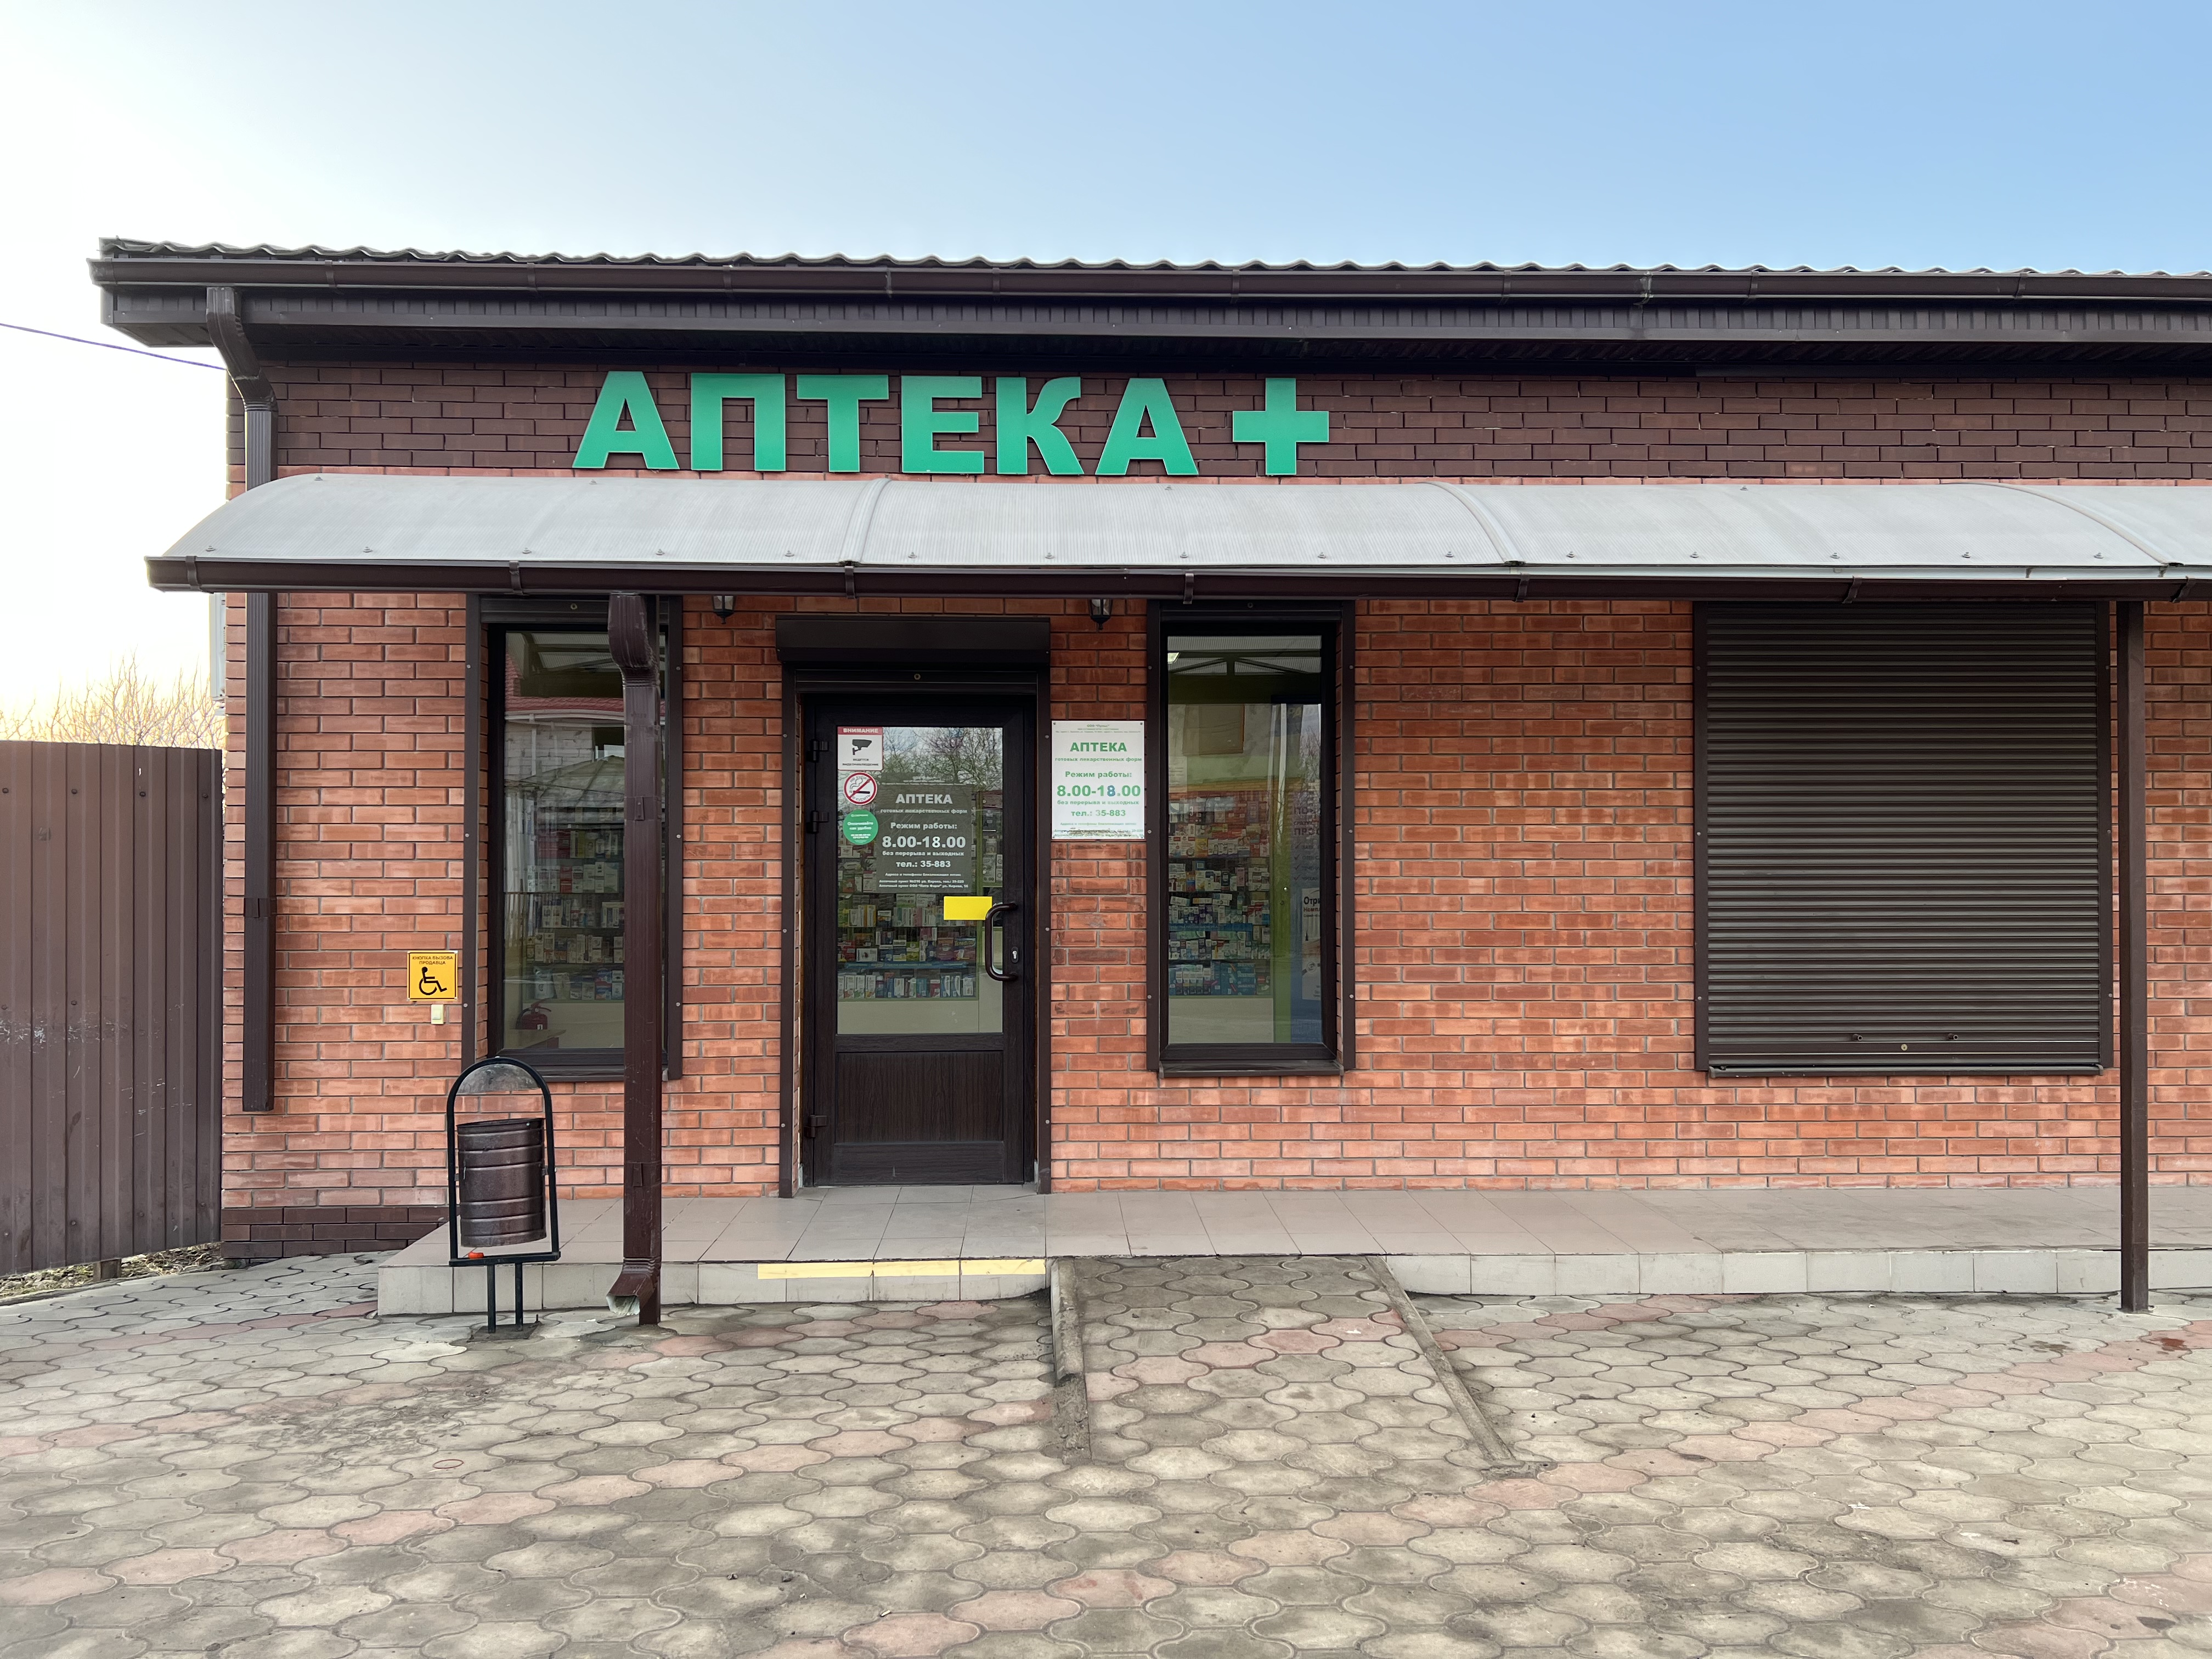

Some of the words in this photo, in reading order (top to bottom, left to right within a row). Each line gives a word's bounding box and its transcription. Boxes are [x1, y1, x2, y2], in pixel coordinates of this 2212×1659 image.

[572, 370, 1200, 476] АПТЕКА
[1070, 742, 1127, 752] АПТЕКА
[1057, 785, 1141, 797] 8.00-18.00
[895, 794, 952, 804] АПТЕКА
[882, 836, 966, 848] 8.00-18.00
